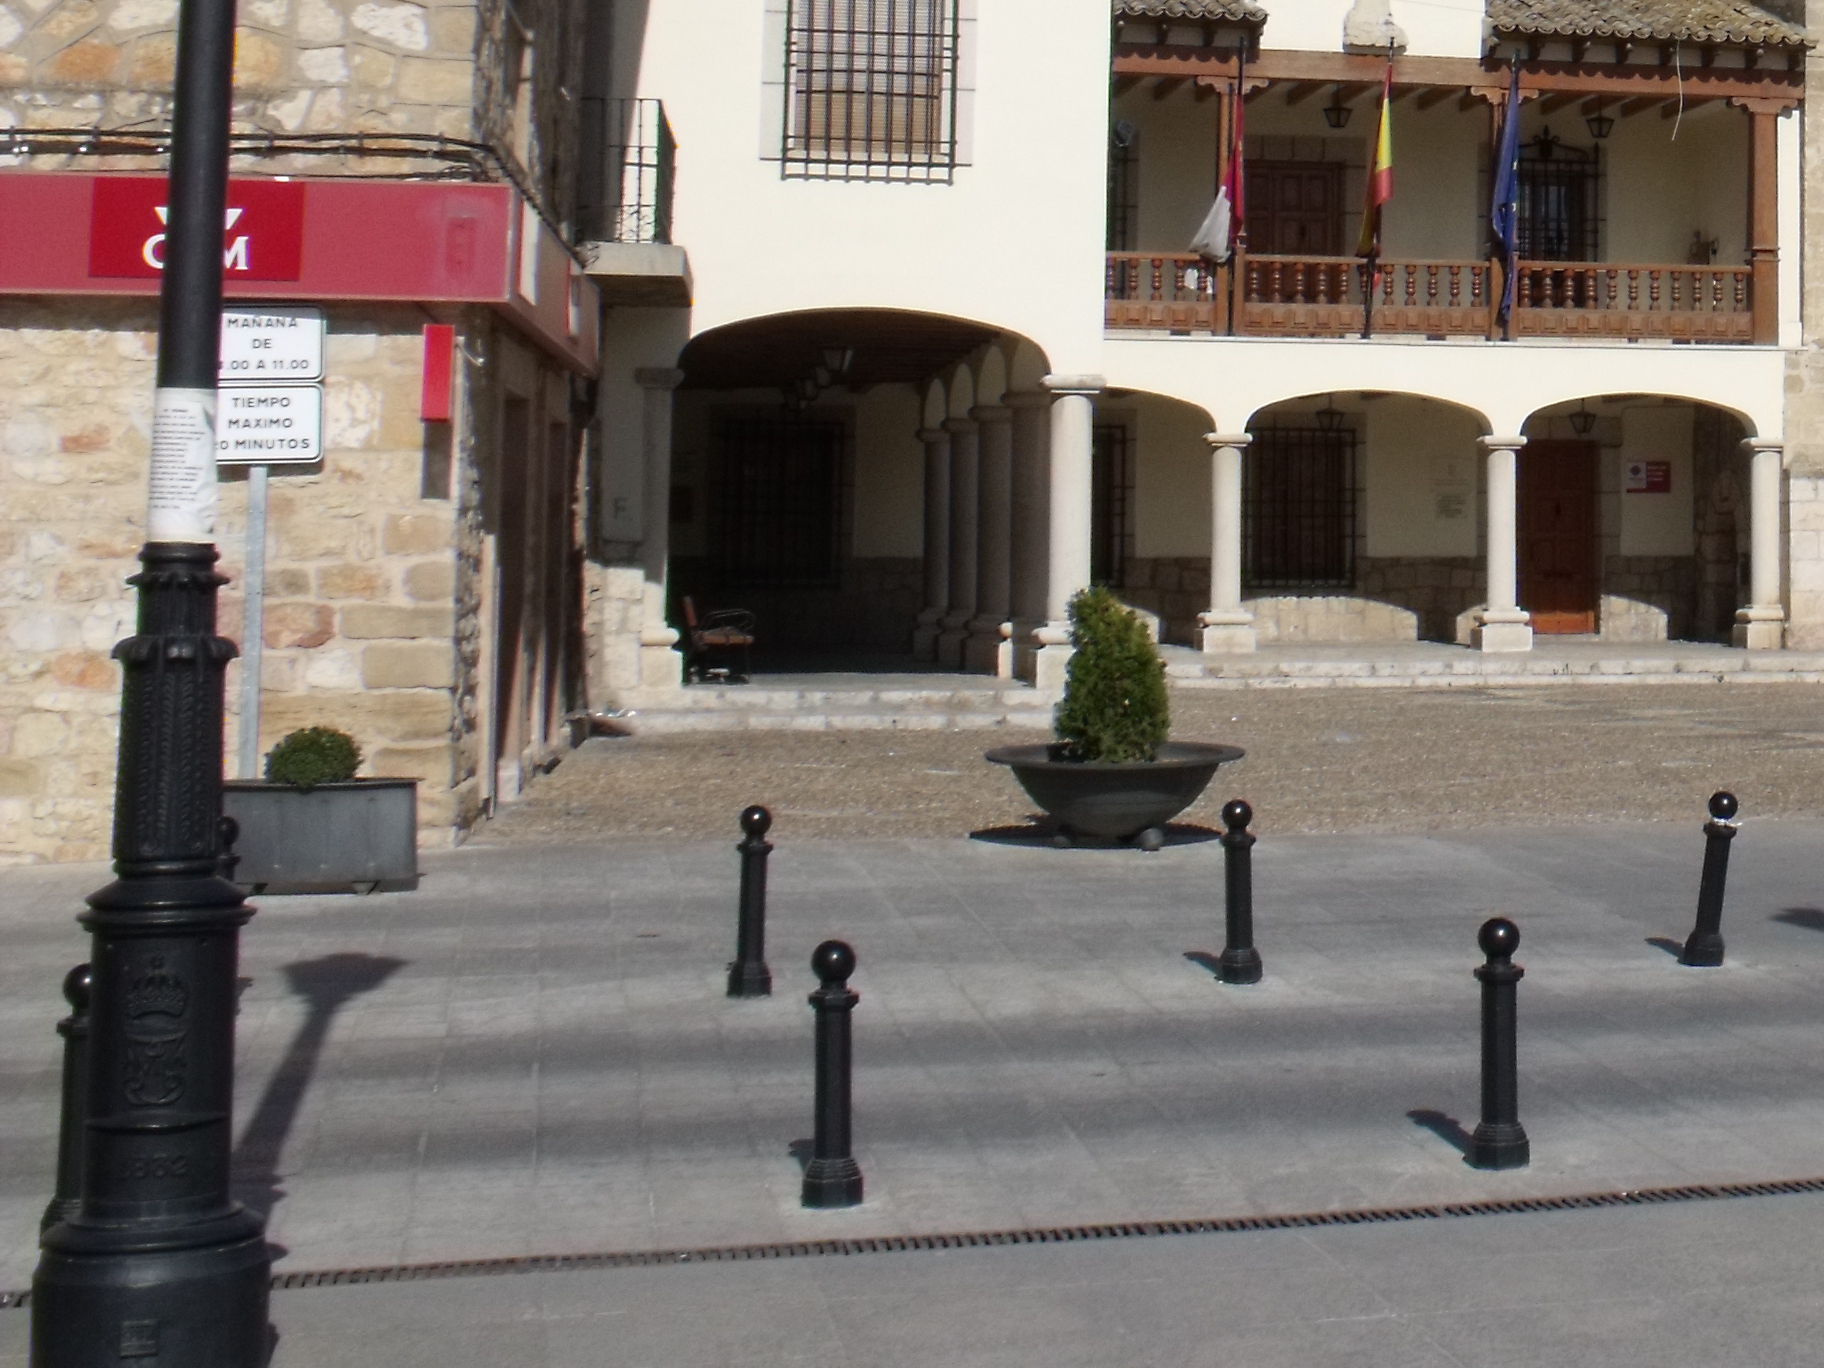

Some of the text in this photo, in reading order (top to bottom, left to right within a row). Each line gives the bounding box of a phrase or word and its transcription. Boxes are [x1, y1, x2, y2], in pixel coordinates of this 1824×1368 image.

[142, 233, 250, 271] CM
[252, 338, 272, 349] DE
[256, 360, 266, 370] A
[272, 359, 309, 370] 11.00
[232, 397, 291, 408] TIEMPO
[228, 418, 293, 429] MAXIMO
[235, 438, 310, 450] MINUTOS
